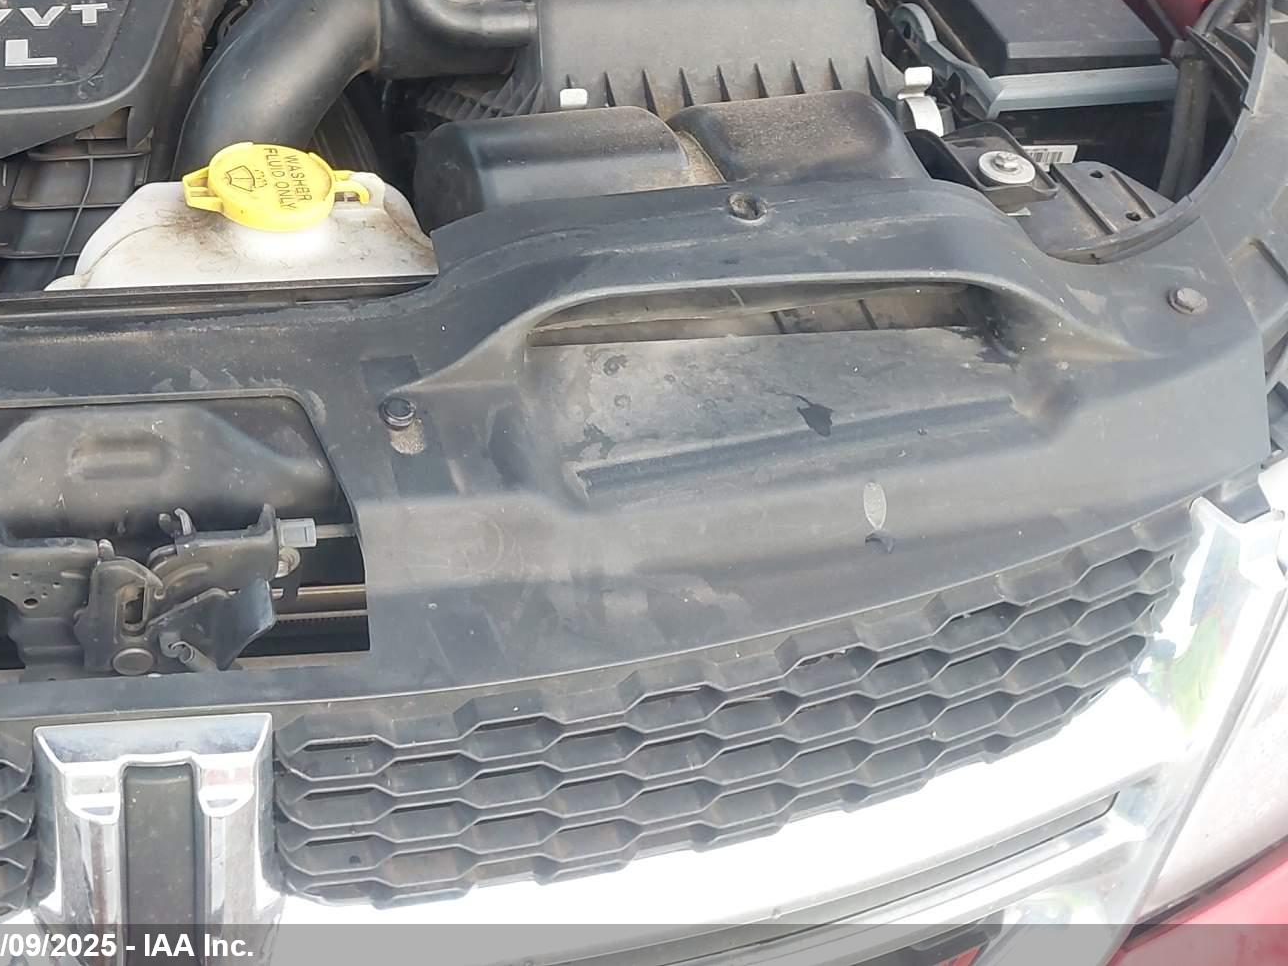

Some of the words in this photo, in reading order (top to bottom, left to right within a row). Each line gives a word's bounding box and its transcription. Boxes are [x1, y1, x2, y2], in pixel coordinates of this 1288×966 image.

[264, 147, 287, 177] FLUID
[285, 155, 313, 202] WASHER
[275, 181, 297, 211] ONLY
